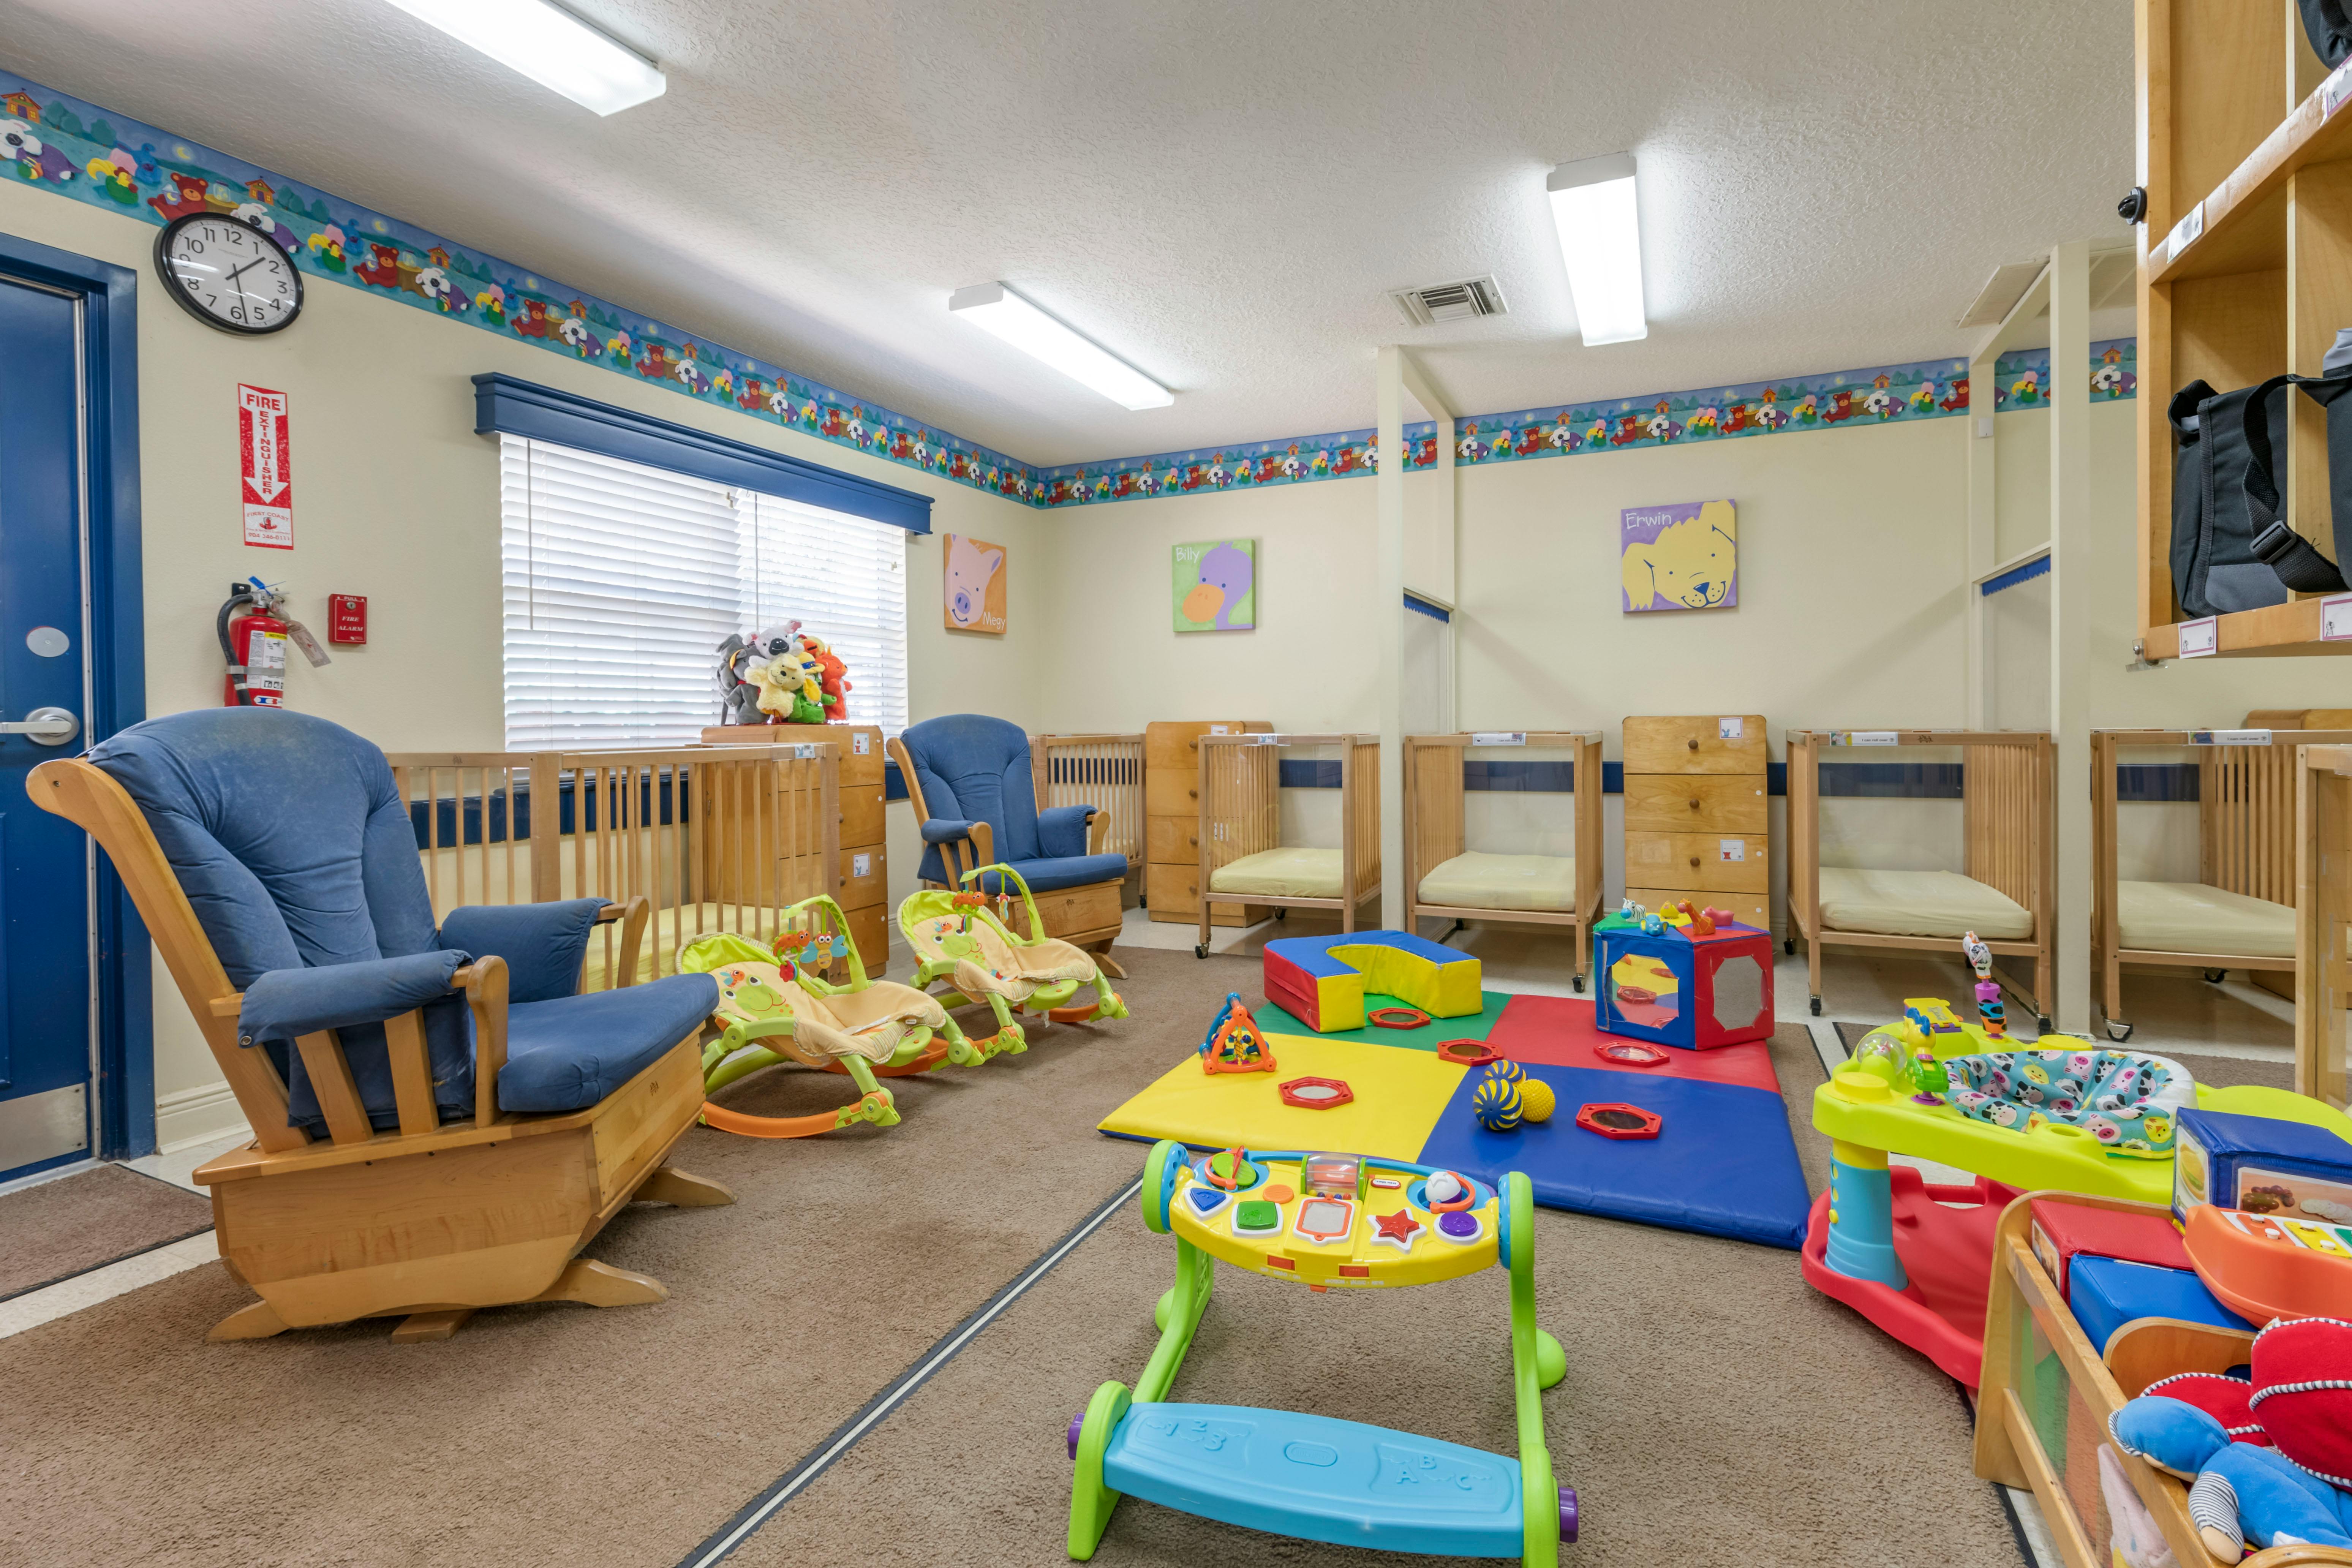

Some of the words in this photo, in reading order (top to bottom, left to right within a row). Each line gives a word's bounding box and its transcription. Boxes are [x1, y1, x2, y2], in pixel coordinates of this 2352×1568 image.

[203, 228, 215, 242] 11
[224, 228, 242, 245] 12
[184, 237, 204, 254] 10
[253, 241, 259, 254] 1
[268, 261, 279, 274] 2
[187, 277, 199, 290] 8
[277, 280, 287, 294] 3
[206, 294, 217, 307] 7
[269, 298, 281, 311] 4
[230, 306, 242, 319] 6
[254, 307, 265, 320] 5
[246, 393, 281, 411] FIRE
[259, 410, 272, 495] EXTINGUISHER
[267, 512, 289, 521] COAST
[1625, 512, 1672, 530] Erwin
[1176, 547, 1200, 564] Billy
[983, 611, 1006, 631] Megy
[1166, 1420, 1179, 1436] 1
[1191, 1419, 1208, 1432] 2
[1204, 1432, 1227, 1451] 3
[1396, 1464, 1419, 1484] A
[1418, 1453, 1437, 1470] B
[1456, 1471, 1472, 1491] C
